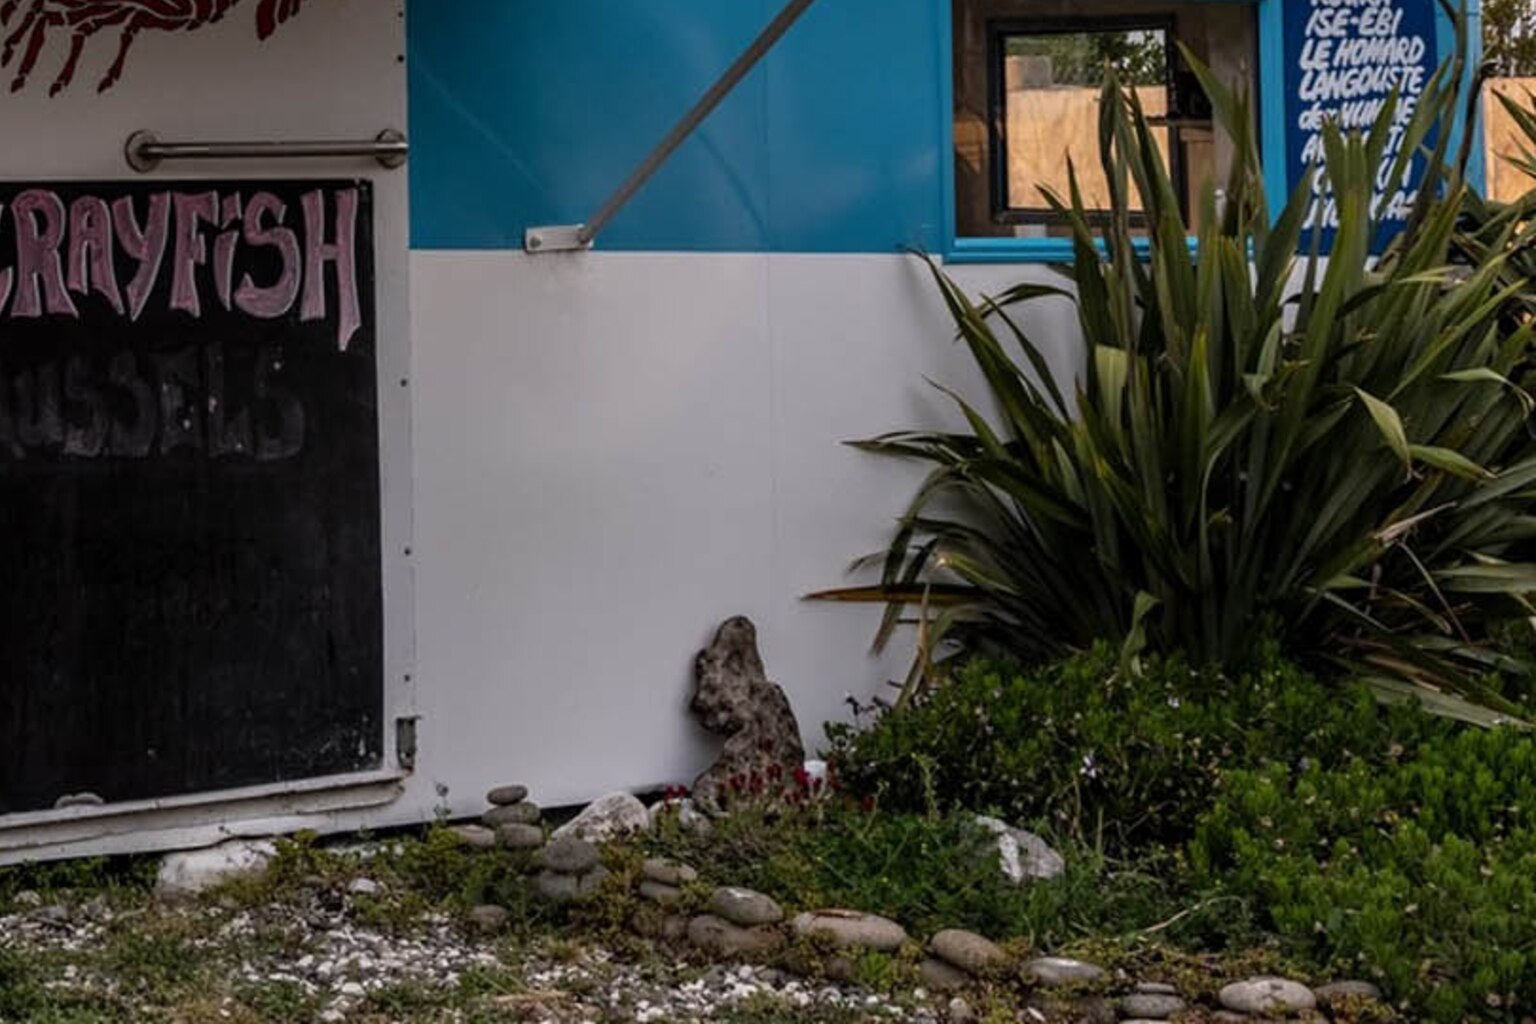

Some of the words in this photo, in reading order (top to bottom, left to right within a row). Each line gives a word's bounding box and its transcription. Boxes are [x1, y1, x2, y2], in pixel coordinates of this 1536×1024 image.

[1305, 7, 1403, 38] ISE-EBI
[1299, 39, 1332, 70] LE
[1333, 35, 1425, 67] HOMARD
[1298, 66, 1425, 100] LANGOUSTE
